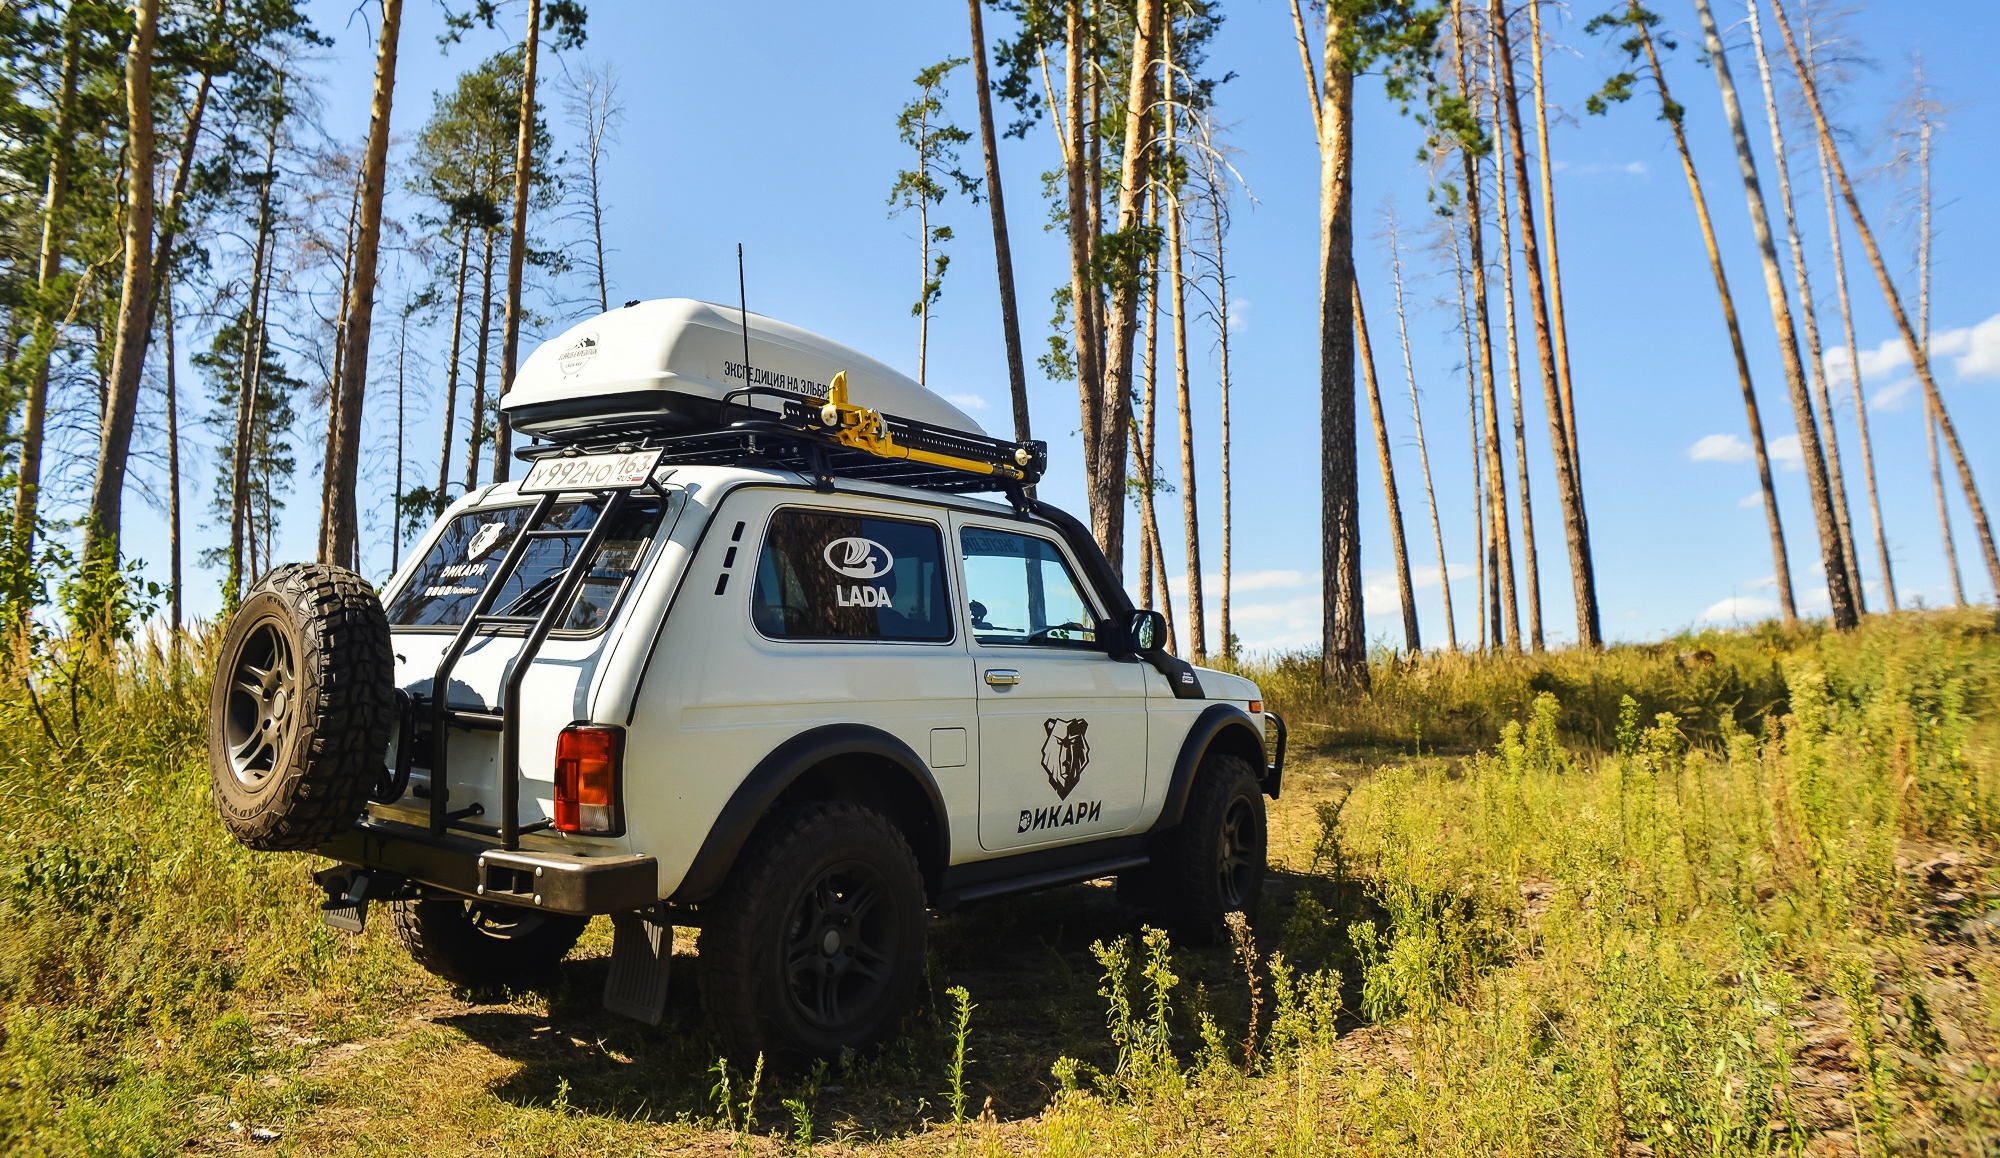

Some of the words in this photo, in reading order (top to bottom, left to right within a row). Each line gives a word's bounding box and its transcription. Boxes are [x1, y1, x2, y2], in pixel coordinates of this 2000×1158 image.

[724, 360, 786, 389] ЭКСПЕДИЦИЯ
[787, 375, 799, 392] НА
[618, 454, 653, 475] 163
[615, 474, 632, 482] RUS
[836, 584, 893, 608] LADA
